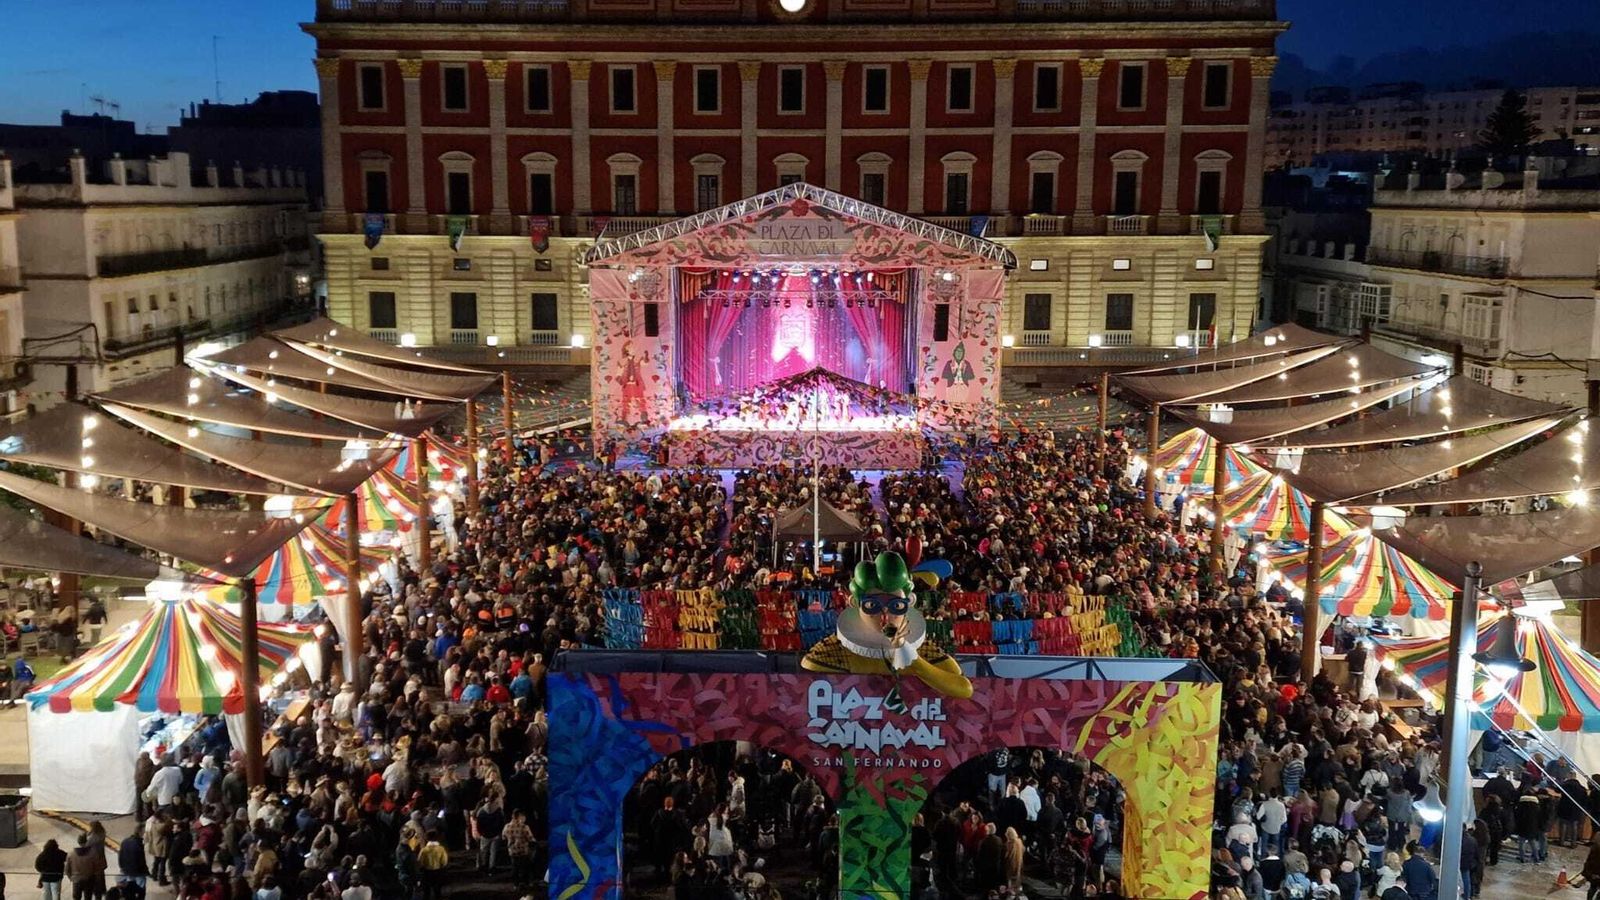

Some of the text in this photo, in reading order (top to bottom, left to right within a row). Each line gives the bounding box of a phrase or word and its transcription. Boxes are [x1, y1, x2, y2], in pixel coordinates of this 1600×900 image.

[761, 225, 812, 240] PLAZA
[759, 241, 841, 255] CARNAVAL
[813, 758, 942, 768] SAN FERNANDO
